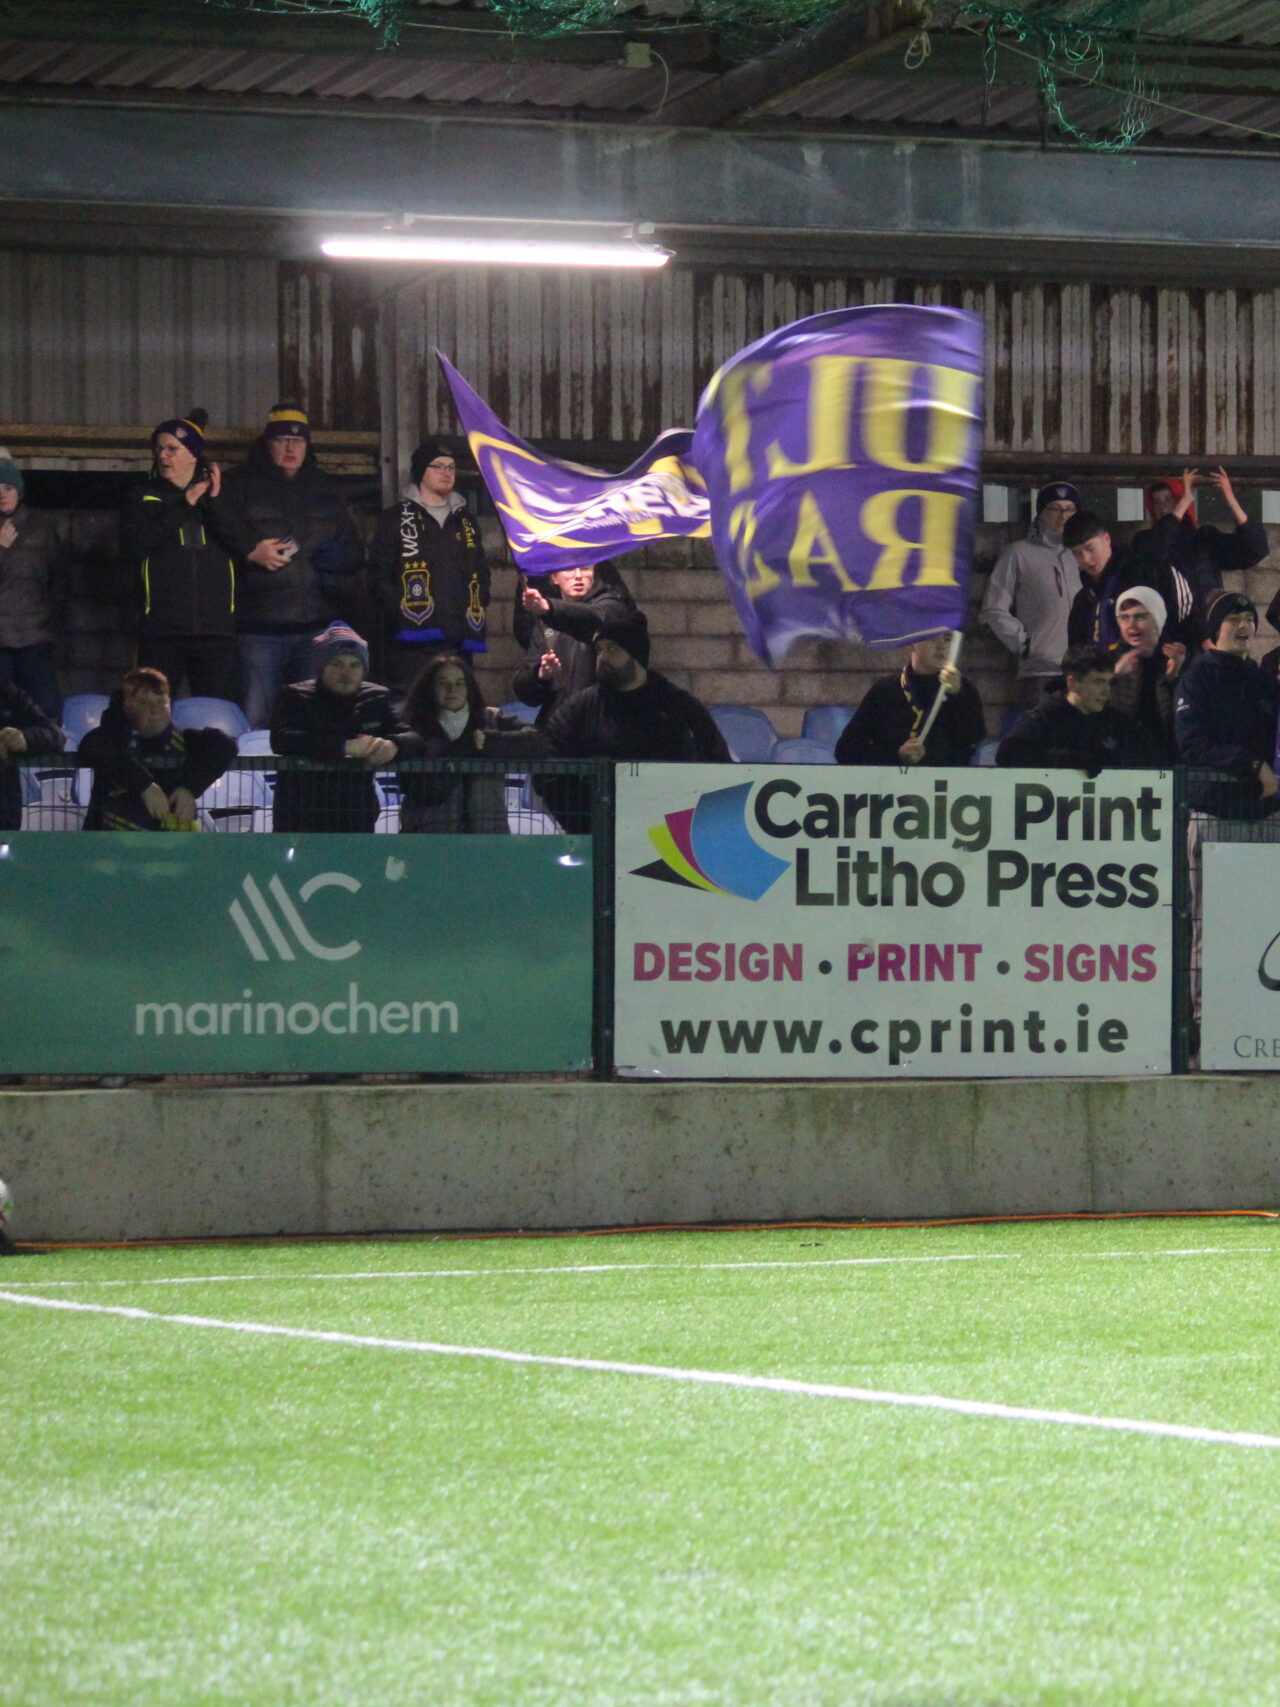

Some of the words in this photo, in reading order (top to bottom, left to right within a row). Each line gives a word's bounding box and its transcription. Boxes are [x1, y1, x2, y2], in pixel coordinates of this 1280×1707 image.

[754, 778, 992, 852] Carraig
[1014, 780, 1161, 841] Print
[795, 846, 965, 908] Litho
[987, 849, 1160, 908] Press
[633, 942, 803, 982] DESIGN
[847, 943, 982, 982] PRINT
[1024, 943, 1157, 983] SIGNS
[136, 983, 458, 1035] marinochem
[661, 1003, 1129, 1065] www.cprint.ie
